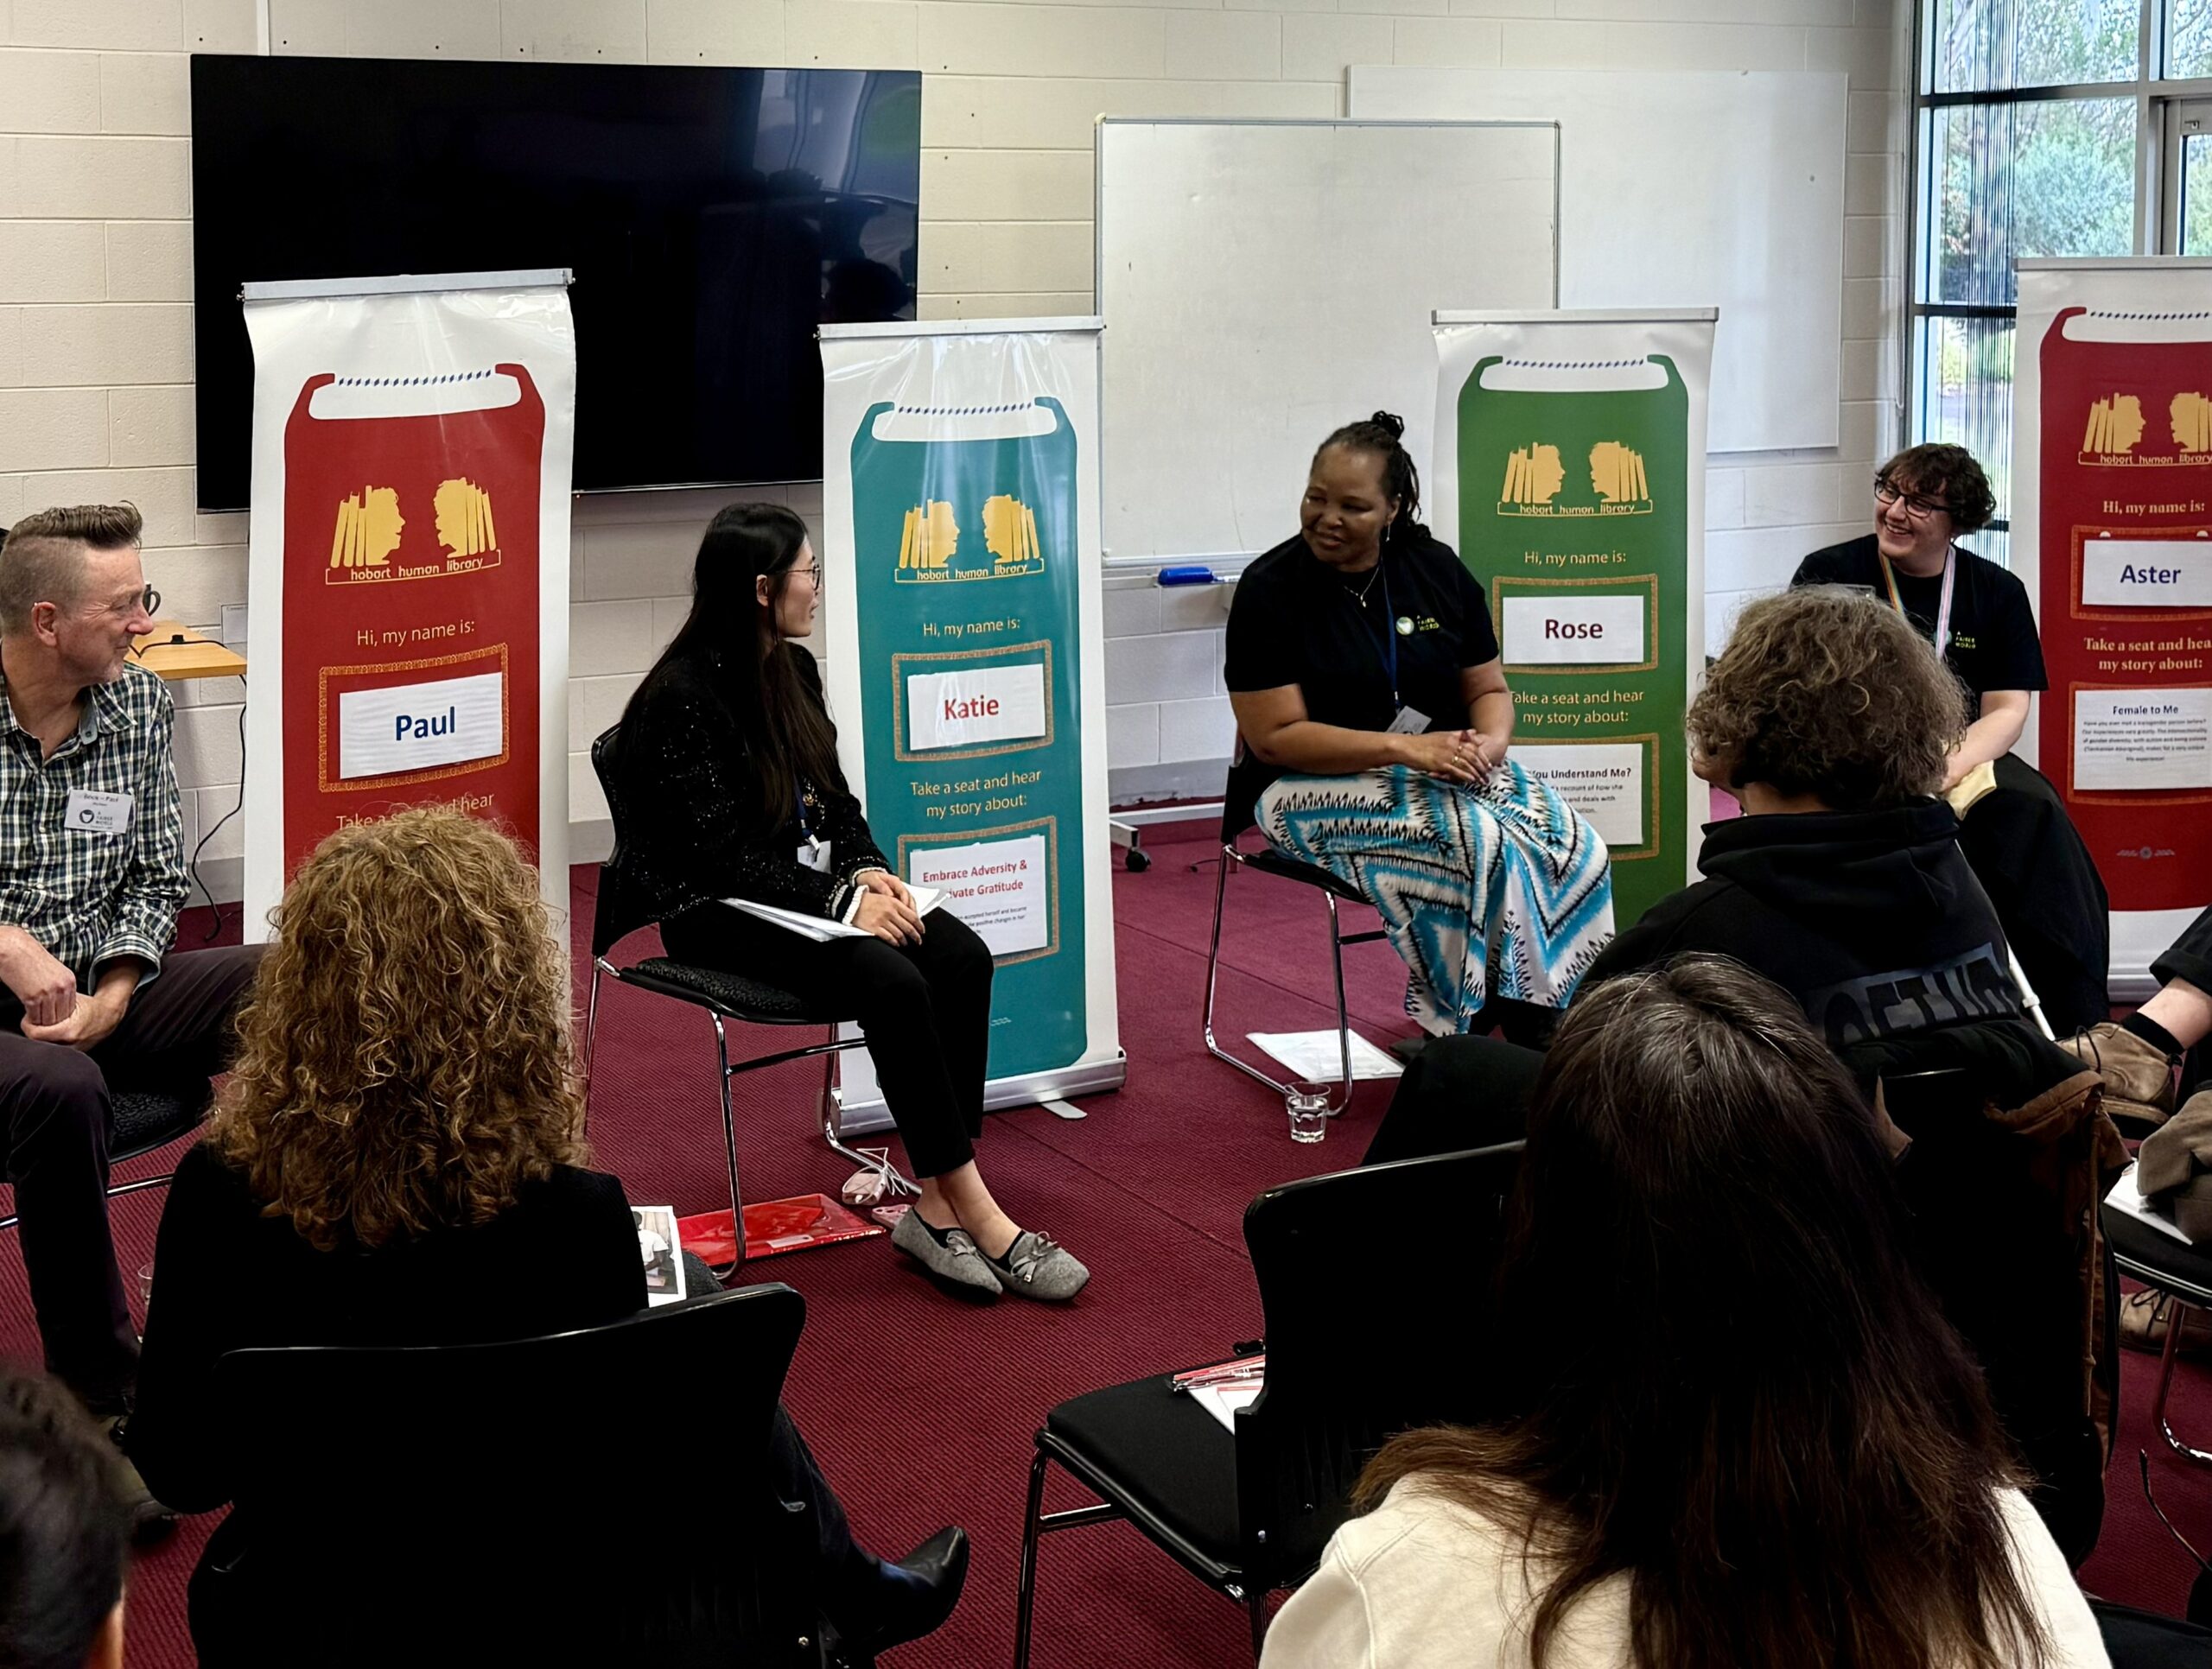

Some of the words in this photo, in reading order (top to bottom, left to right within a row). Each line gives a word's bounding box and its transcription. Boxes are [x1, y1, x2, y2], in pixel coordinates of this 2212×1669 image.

[2101, 454, 2133, 464] hobart
[1520, 505, 1553, 514] hobart
[1560, 505, 1593, 514] human
[1600, 503, 1635, 514] library
[2103, 501, 2122, 514] Hi,
[2126, 505, 2145, 516] my
[2150, 503, 2186, 513] name
[2190, 500, 2204, 511] is:
[1524, 551, 1541, 565] Hi,
[1546, 554, 1566, 567] my
[1571, 552, 1608, 564] name
[1613, 550, 1626, 562] is:
[351, 568, 391, 581] hobart
[398, 565, 439, 577] human
[447, 558, 483, 572] library
[917, 569, 949, 581] hobart
[956, 568, 988, 579] human
[995, 564, 1027, 575] library
[2120, 564, 2181, 584] Aster
[357, 630, 378, 646] Hi,
[384, 631, 406, 646] my
[412, 625, 455, 641] name
[460, 619, 475, 634] is:
[924, 623, 940, 637] Hi,
[944, 625, 963, 638] my
[968, 620, 1003, 633] name
[1007, 617, 1020, 629] is:
[1545, 619, 1603, 638] Rose
[2084, 638, 2115, 650] Take
[2119, 642, 2126, 650] a
[2129, 640, 2154, 650] seat
[2158, 638, 2183, 650] and
[2187, 637, 2212, 650] hea
[2099, 661, 2119, 673] my
[2122, 659, 2156, 673] story
[2159, 657, 2202, 670] about:
[1541, 695, 1548, 703] a
[1553, 694, 1579, 704] seat
[1584, 691, 1609, 703] and
[1614, 690, 1643, 702] hear
[945, 695, 999, 720] Katie
[2113, 706, 2147, 715] Female
[2152, 706, 2160, 714] to
[396, 706, 455, 741] Paul
[1523, 714, 1543, 726] my
[1548, 713, 1580, 726] story
[1584, 711, 1629, 723] about:
[1551, 769, 1607, 778] Understand
[1611, 768, 1630, 777] Me?
[911, 782, 939, 796] Take
[944, 783, 950, 794] a
[955, 779, 980, 793] seat
[984, 773, 1007, 789] and
[1012, 771, 1041, 785] hear
[461, 794, 494, 813] hear
[926, 806, 945, 819] my
[950, 803, 981, 815] story
[985, 795, 1027, 810] about:
[923, 868, 968, 883] Embrace
[971, 862, 1016, 876] Adversity
[1020, 860, 1027, 869] &
[977, 880, 1023, 896] Gratitude
